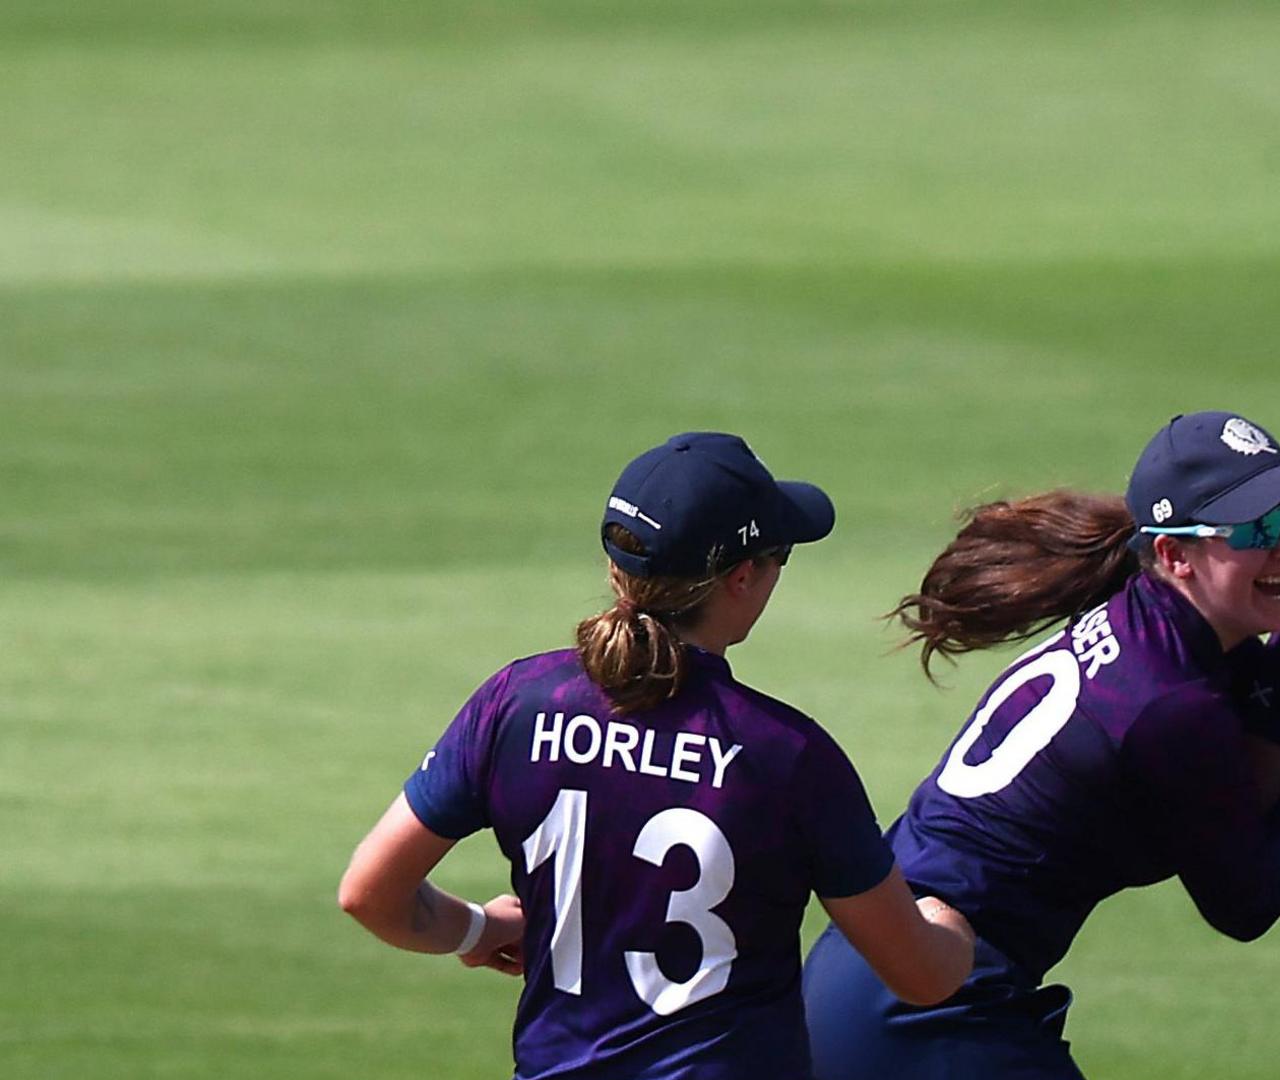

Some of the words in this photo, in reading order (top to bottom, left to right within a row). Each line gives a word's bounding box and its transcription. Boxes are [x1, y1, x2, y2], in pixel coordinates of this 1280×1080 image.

[737, 519, 760, 546] 74
[1152, 498, 1173, 523] 69
[1071, 602, 1121, 680] SER
[530, 712, 743, 788] HORLEY
[936, 630, 1081, 799] 0
[522, 788, 738, 1016] 13
